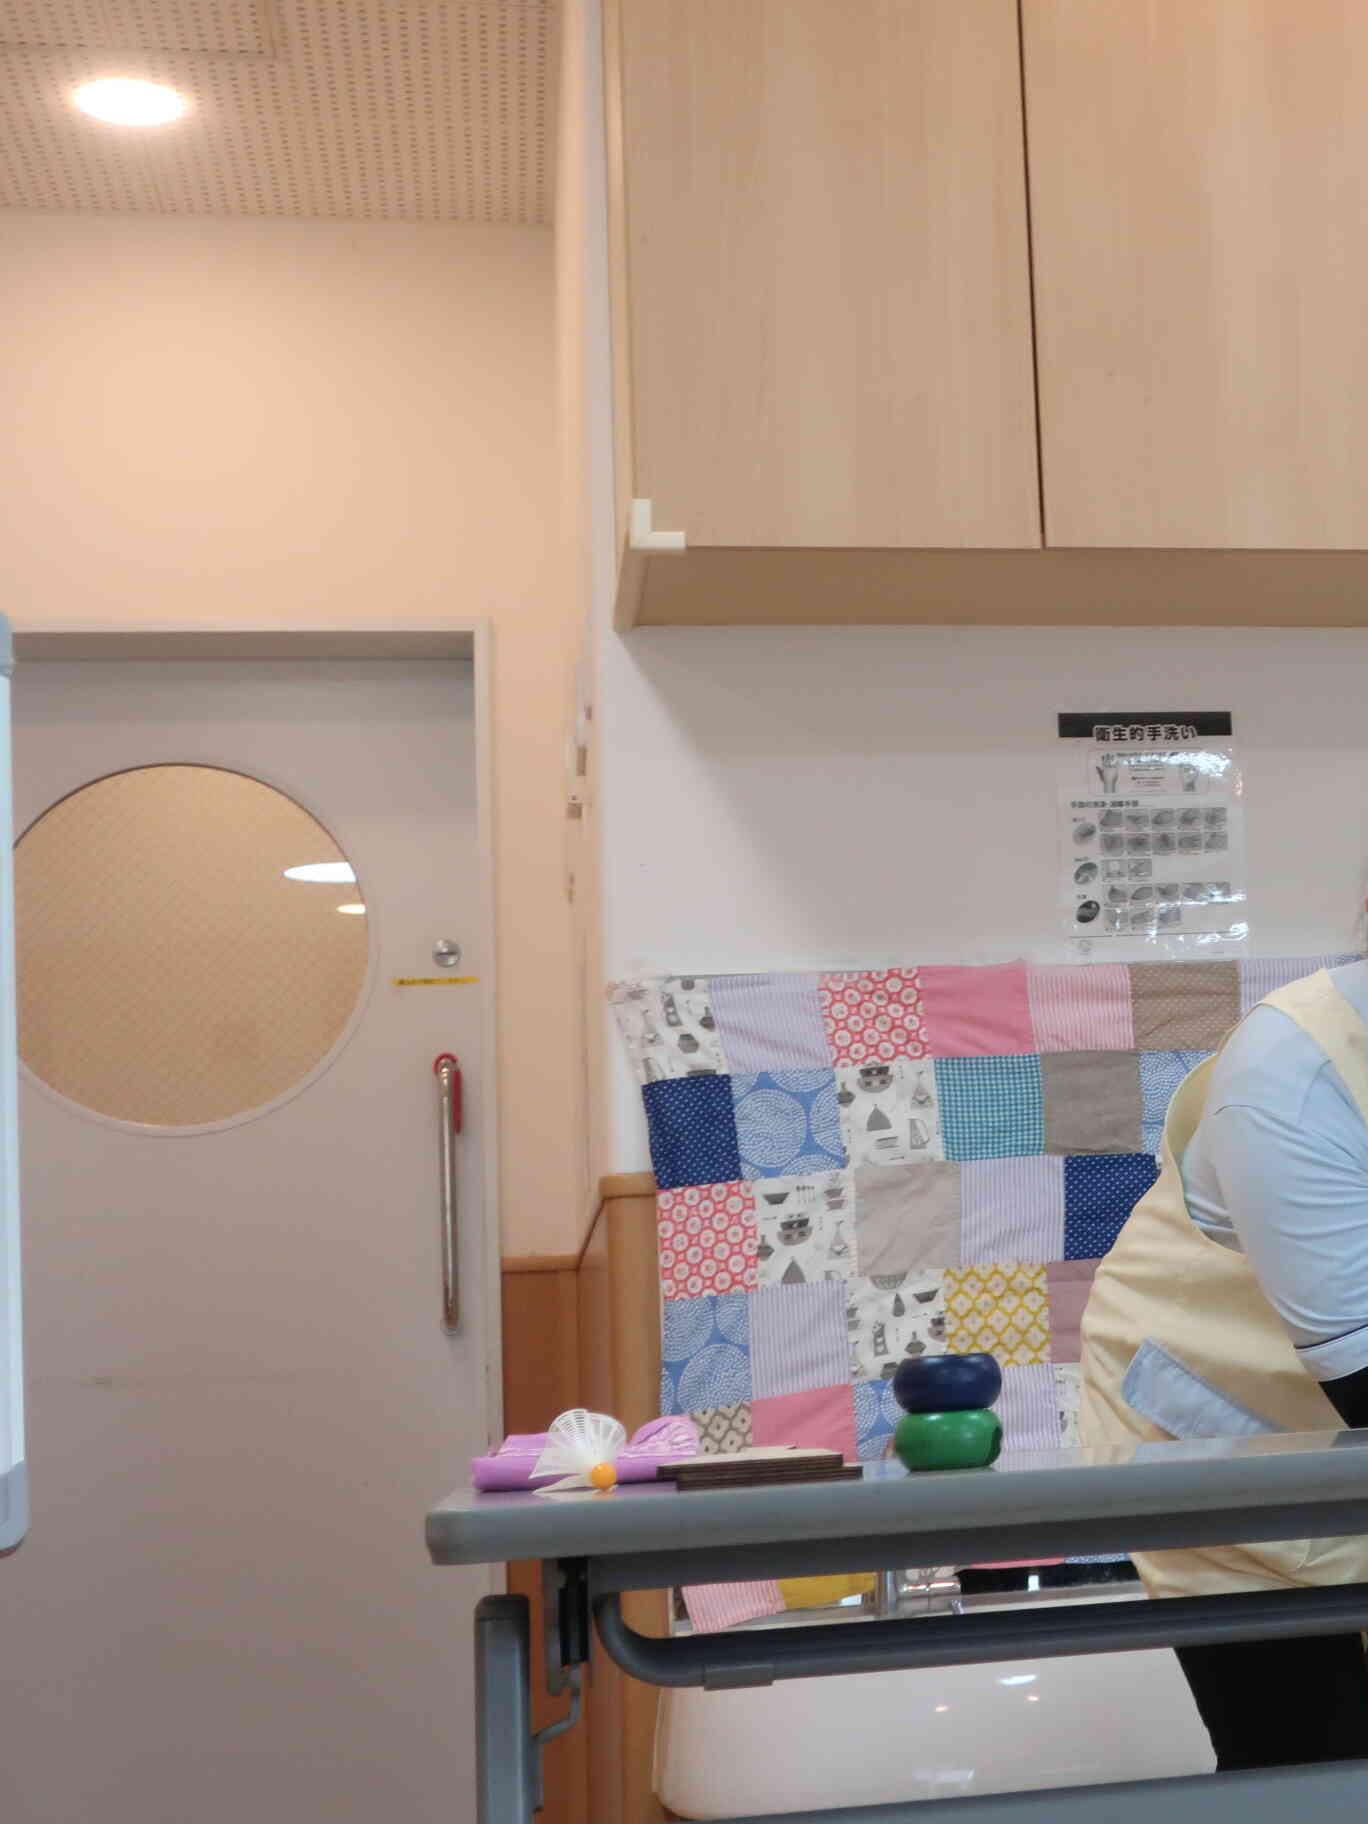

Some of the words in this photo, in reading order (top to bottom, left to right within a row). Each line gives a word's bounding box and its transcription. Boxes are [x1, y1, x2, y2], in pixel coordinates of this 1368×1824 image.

[1094, 725, 1197, 741] 衛生的手洗い
